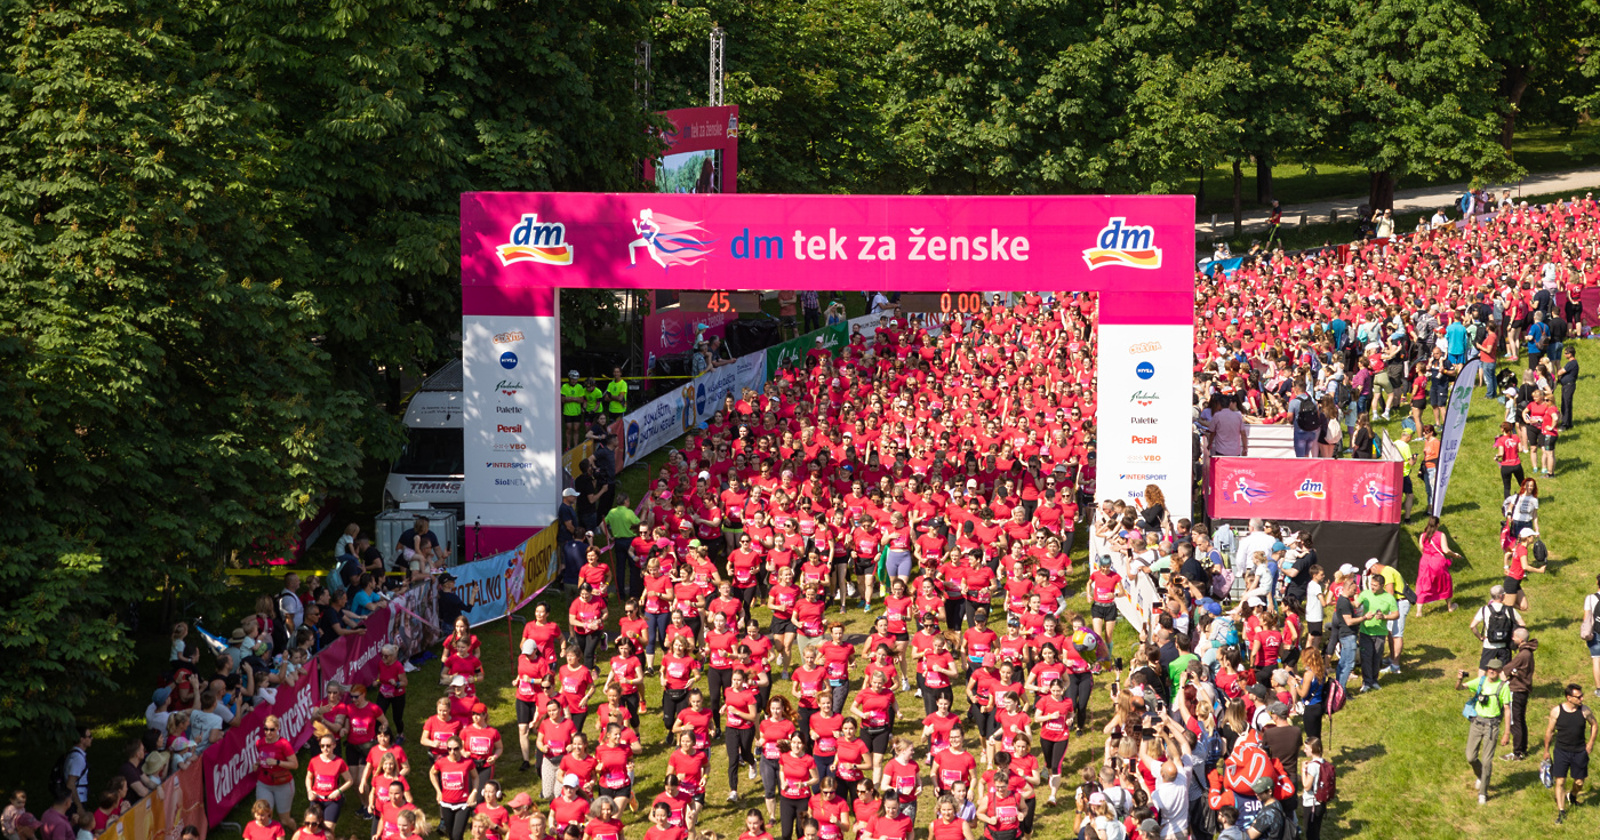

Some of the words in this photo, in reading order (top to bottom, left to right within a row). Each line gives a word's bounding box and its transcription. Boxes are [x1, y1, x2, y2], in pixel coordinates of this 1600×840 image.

[513, 216, 562, 246] dm
[1100, 220, 1151, 250] dm
[730, 227, 783, 259] dm
[793, 228, 848, 260] tek
[858, 235, 896, 261] za
[908, 227, 1030, 261] ženske
[496, 406, 522, 414] Palette
[1130, 416, 1158, 424] Palette
[497, 424, 522, 433] Persil
[1131, 435, 1158, 444] Persil
[1301, 479, 1322, 492] dm
